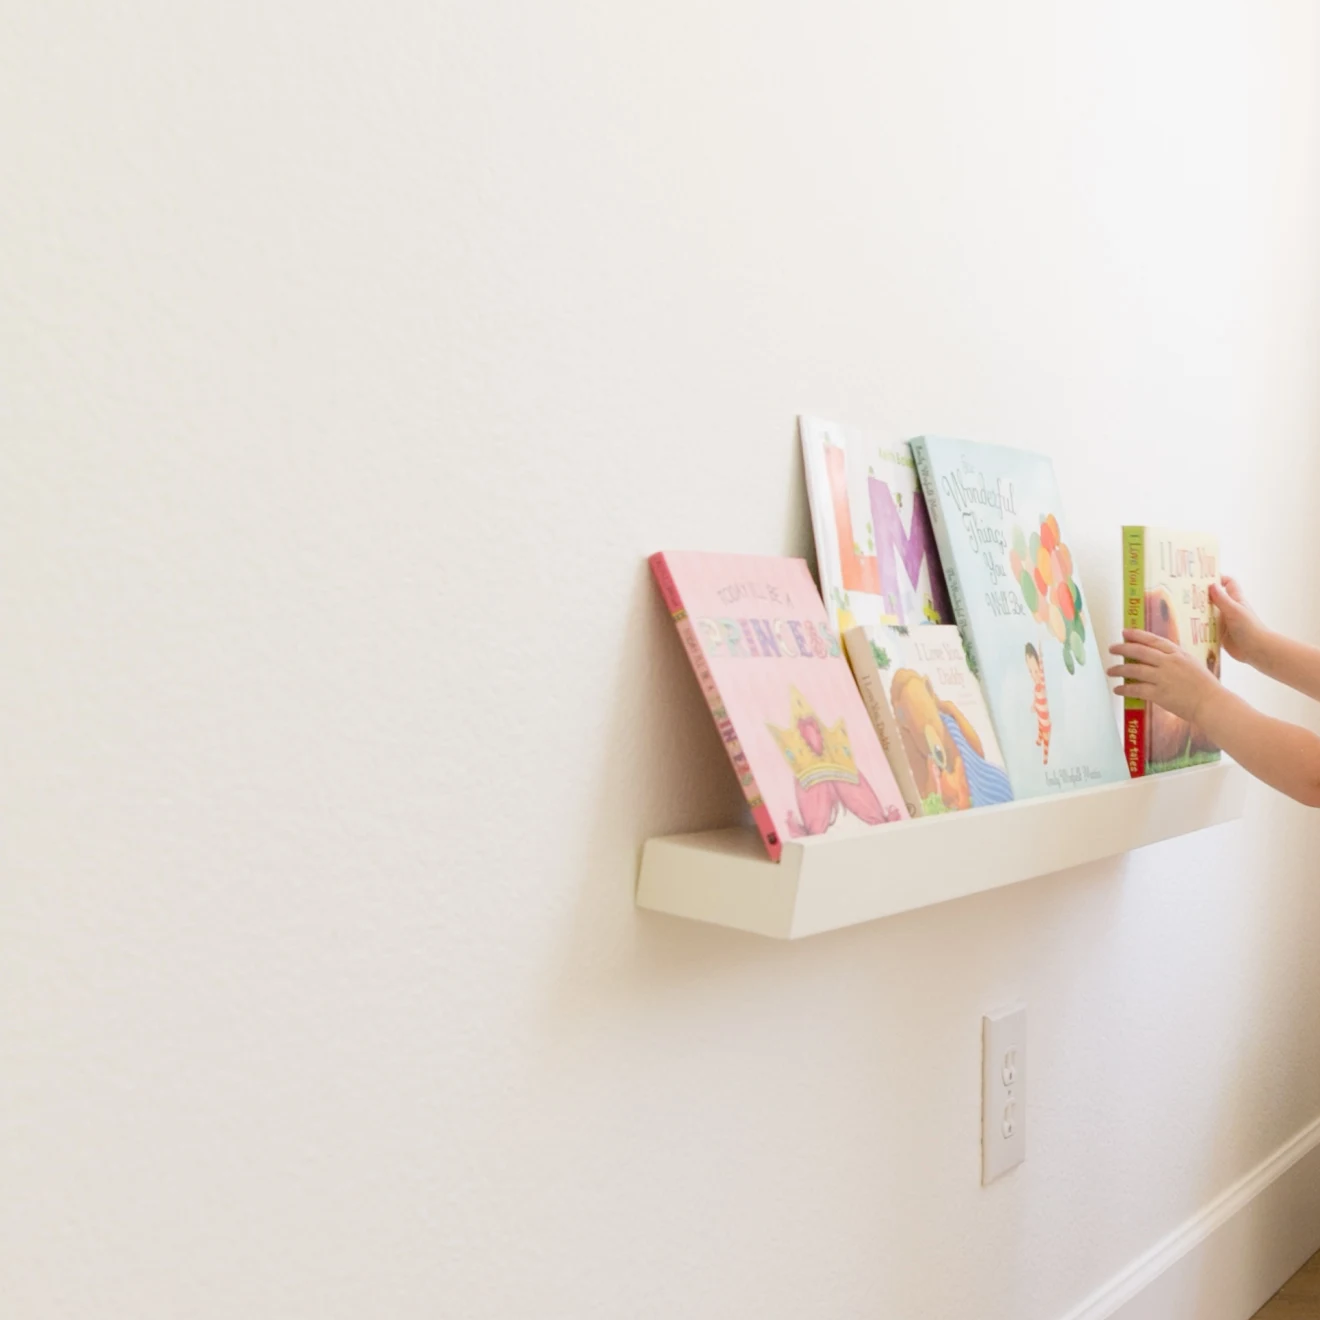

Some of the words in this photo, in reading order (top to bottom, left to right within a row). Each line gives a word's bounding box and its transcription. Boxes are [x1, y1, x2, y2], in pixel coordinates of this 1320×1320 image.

[942, 468, 1016, 520] Wonderful
[962, 511, 1007, 555] Things
[1128, 542, 1142, 565] Love
[983, 552, 1006, 585] You
[1127, 568, 1140, 586] You
[986, 591, 1010, 617] Will
[1009, 591, 1026, 617] Be
[1127, 720, 1139, 744] tiger
[1128, 746, 1139, 773] tales
